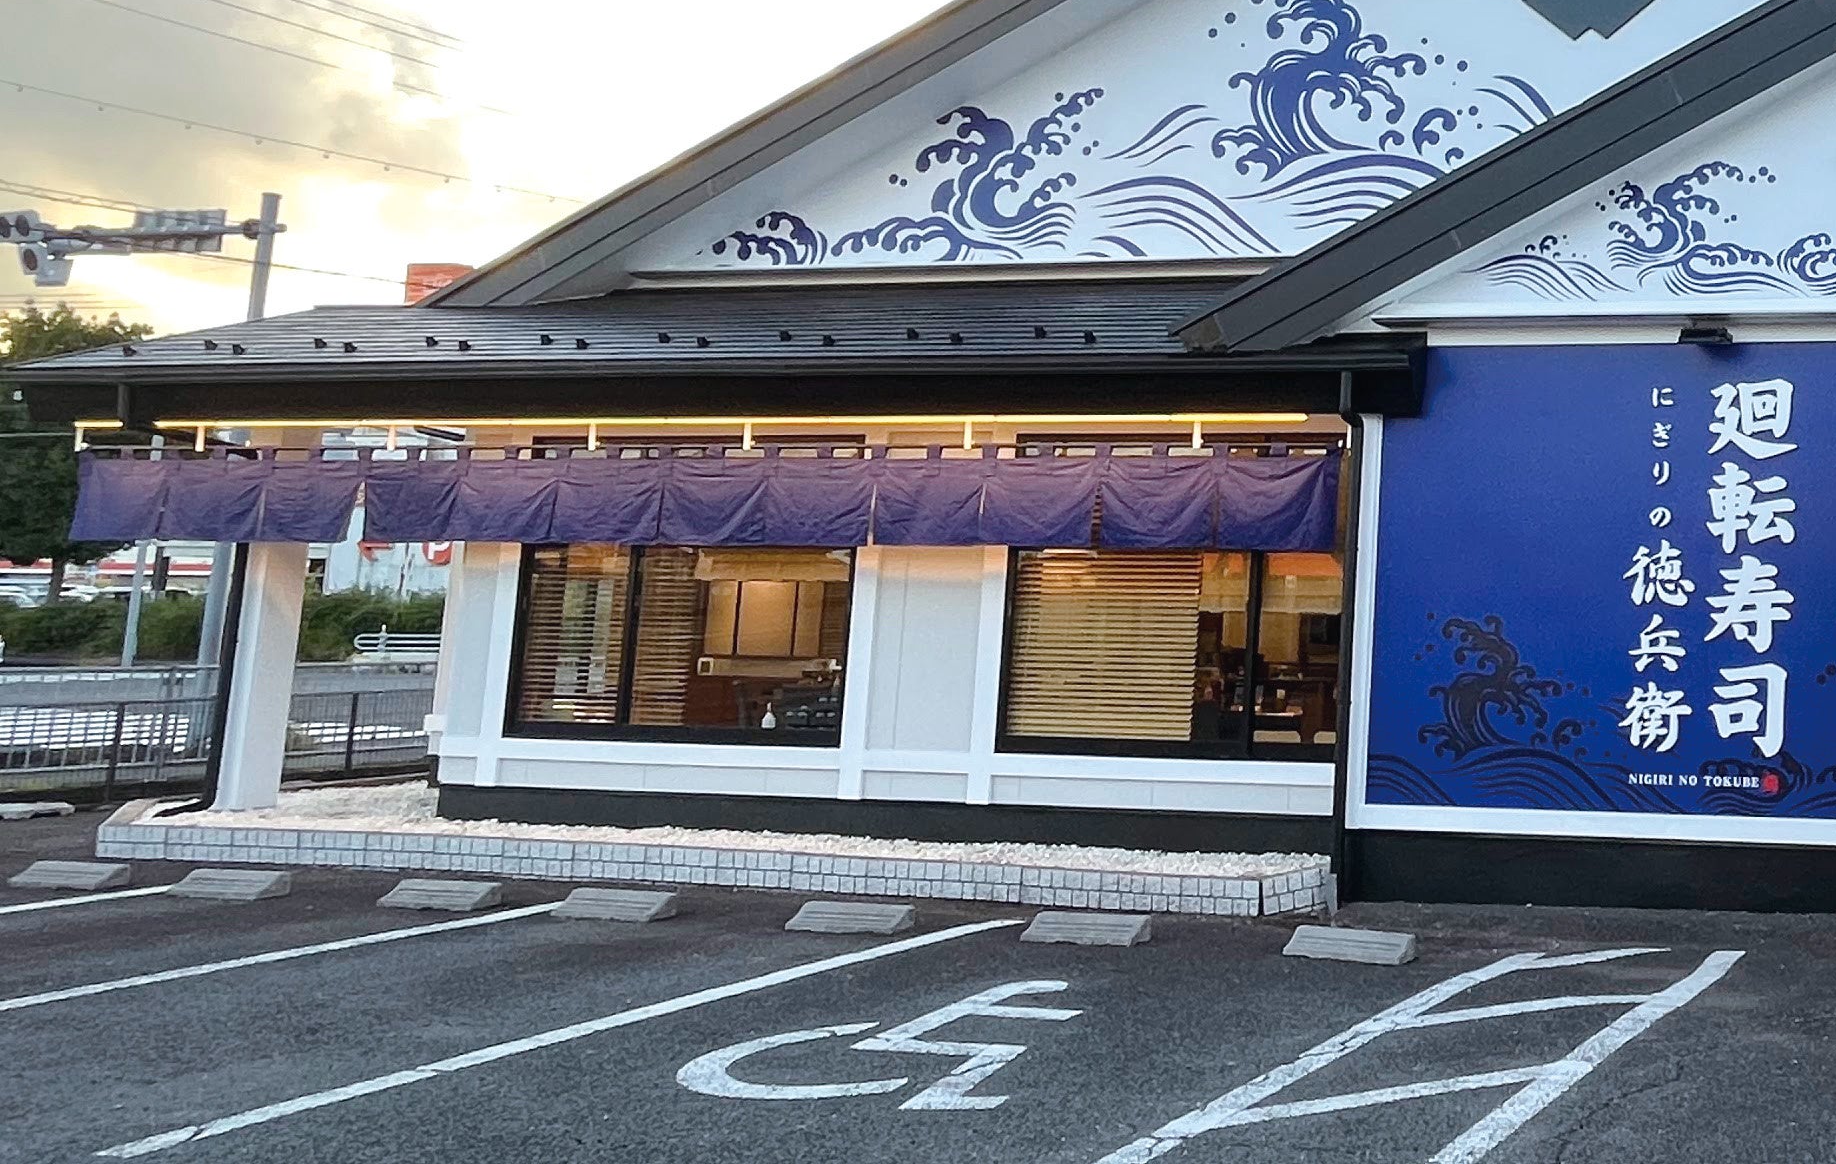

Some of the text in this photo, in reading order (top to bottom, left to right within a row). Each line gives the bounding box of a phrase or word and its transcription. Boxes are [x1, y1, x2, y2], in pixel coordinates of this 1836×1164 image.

[1704, 378, 1798, 759] 廻転寿司
[1628, 773, 1673, 786] NIGIRI
[1679, 775, 1698, 786] NO
[1703, 776, 1760, 788] TOKUBE
